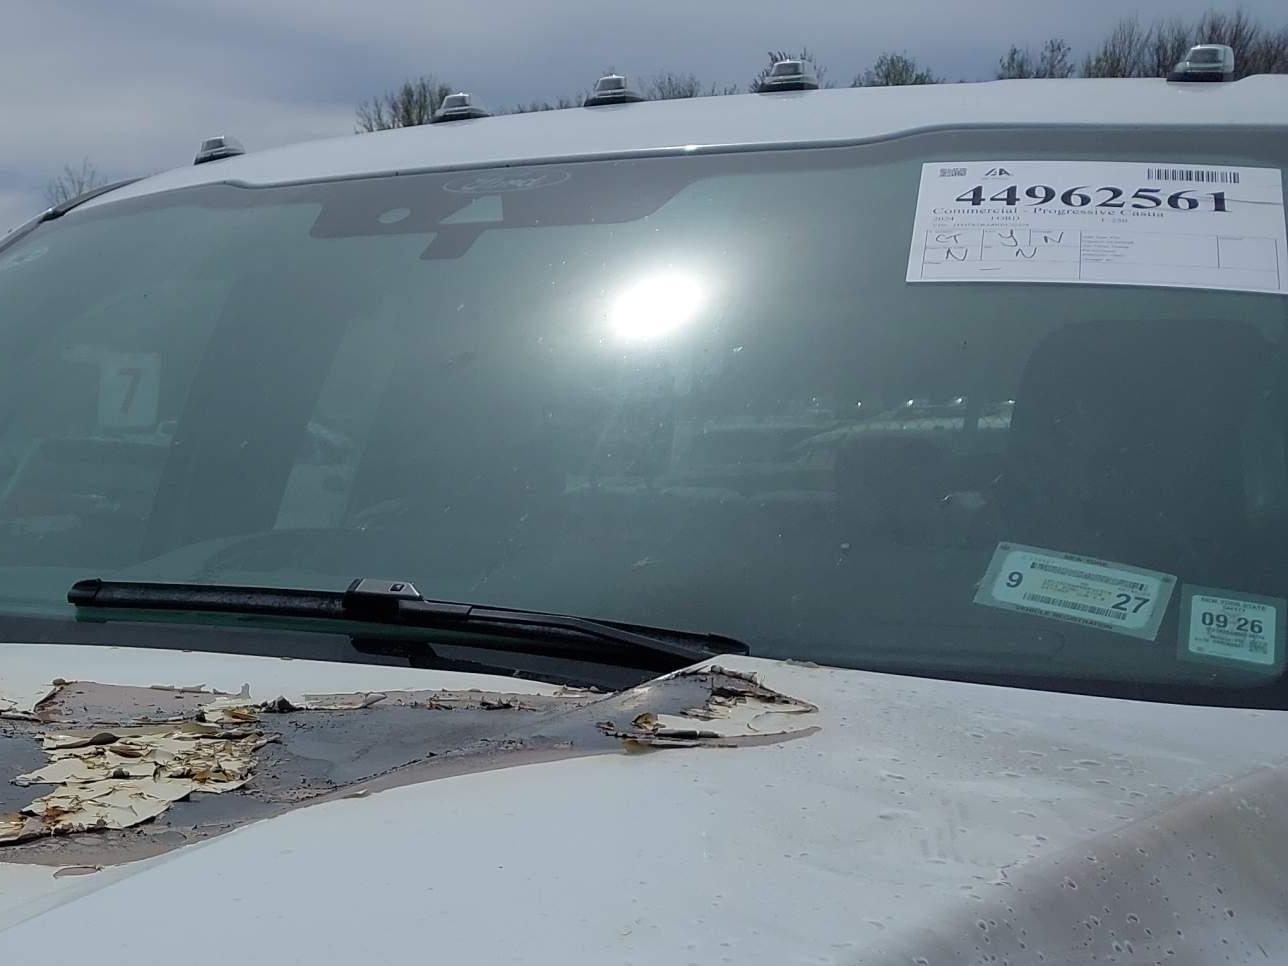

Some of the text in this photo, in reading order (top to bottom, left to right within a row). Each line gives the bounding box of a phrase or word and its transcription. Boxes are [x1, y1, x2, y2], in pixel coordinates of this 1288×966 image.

[955, 185, 1232, 213] 44962561
[1033, 208, 1113, 217] Progressive
[119, 367, 142, 415] 7
[1005, 571, 1024, 588] 9
[1112, 593, 1151, 614] 27
[1201, 611, 1228, 628] 09
[1236, 617, 1264, 634] 26
